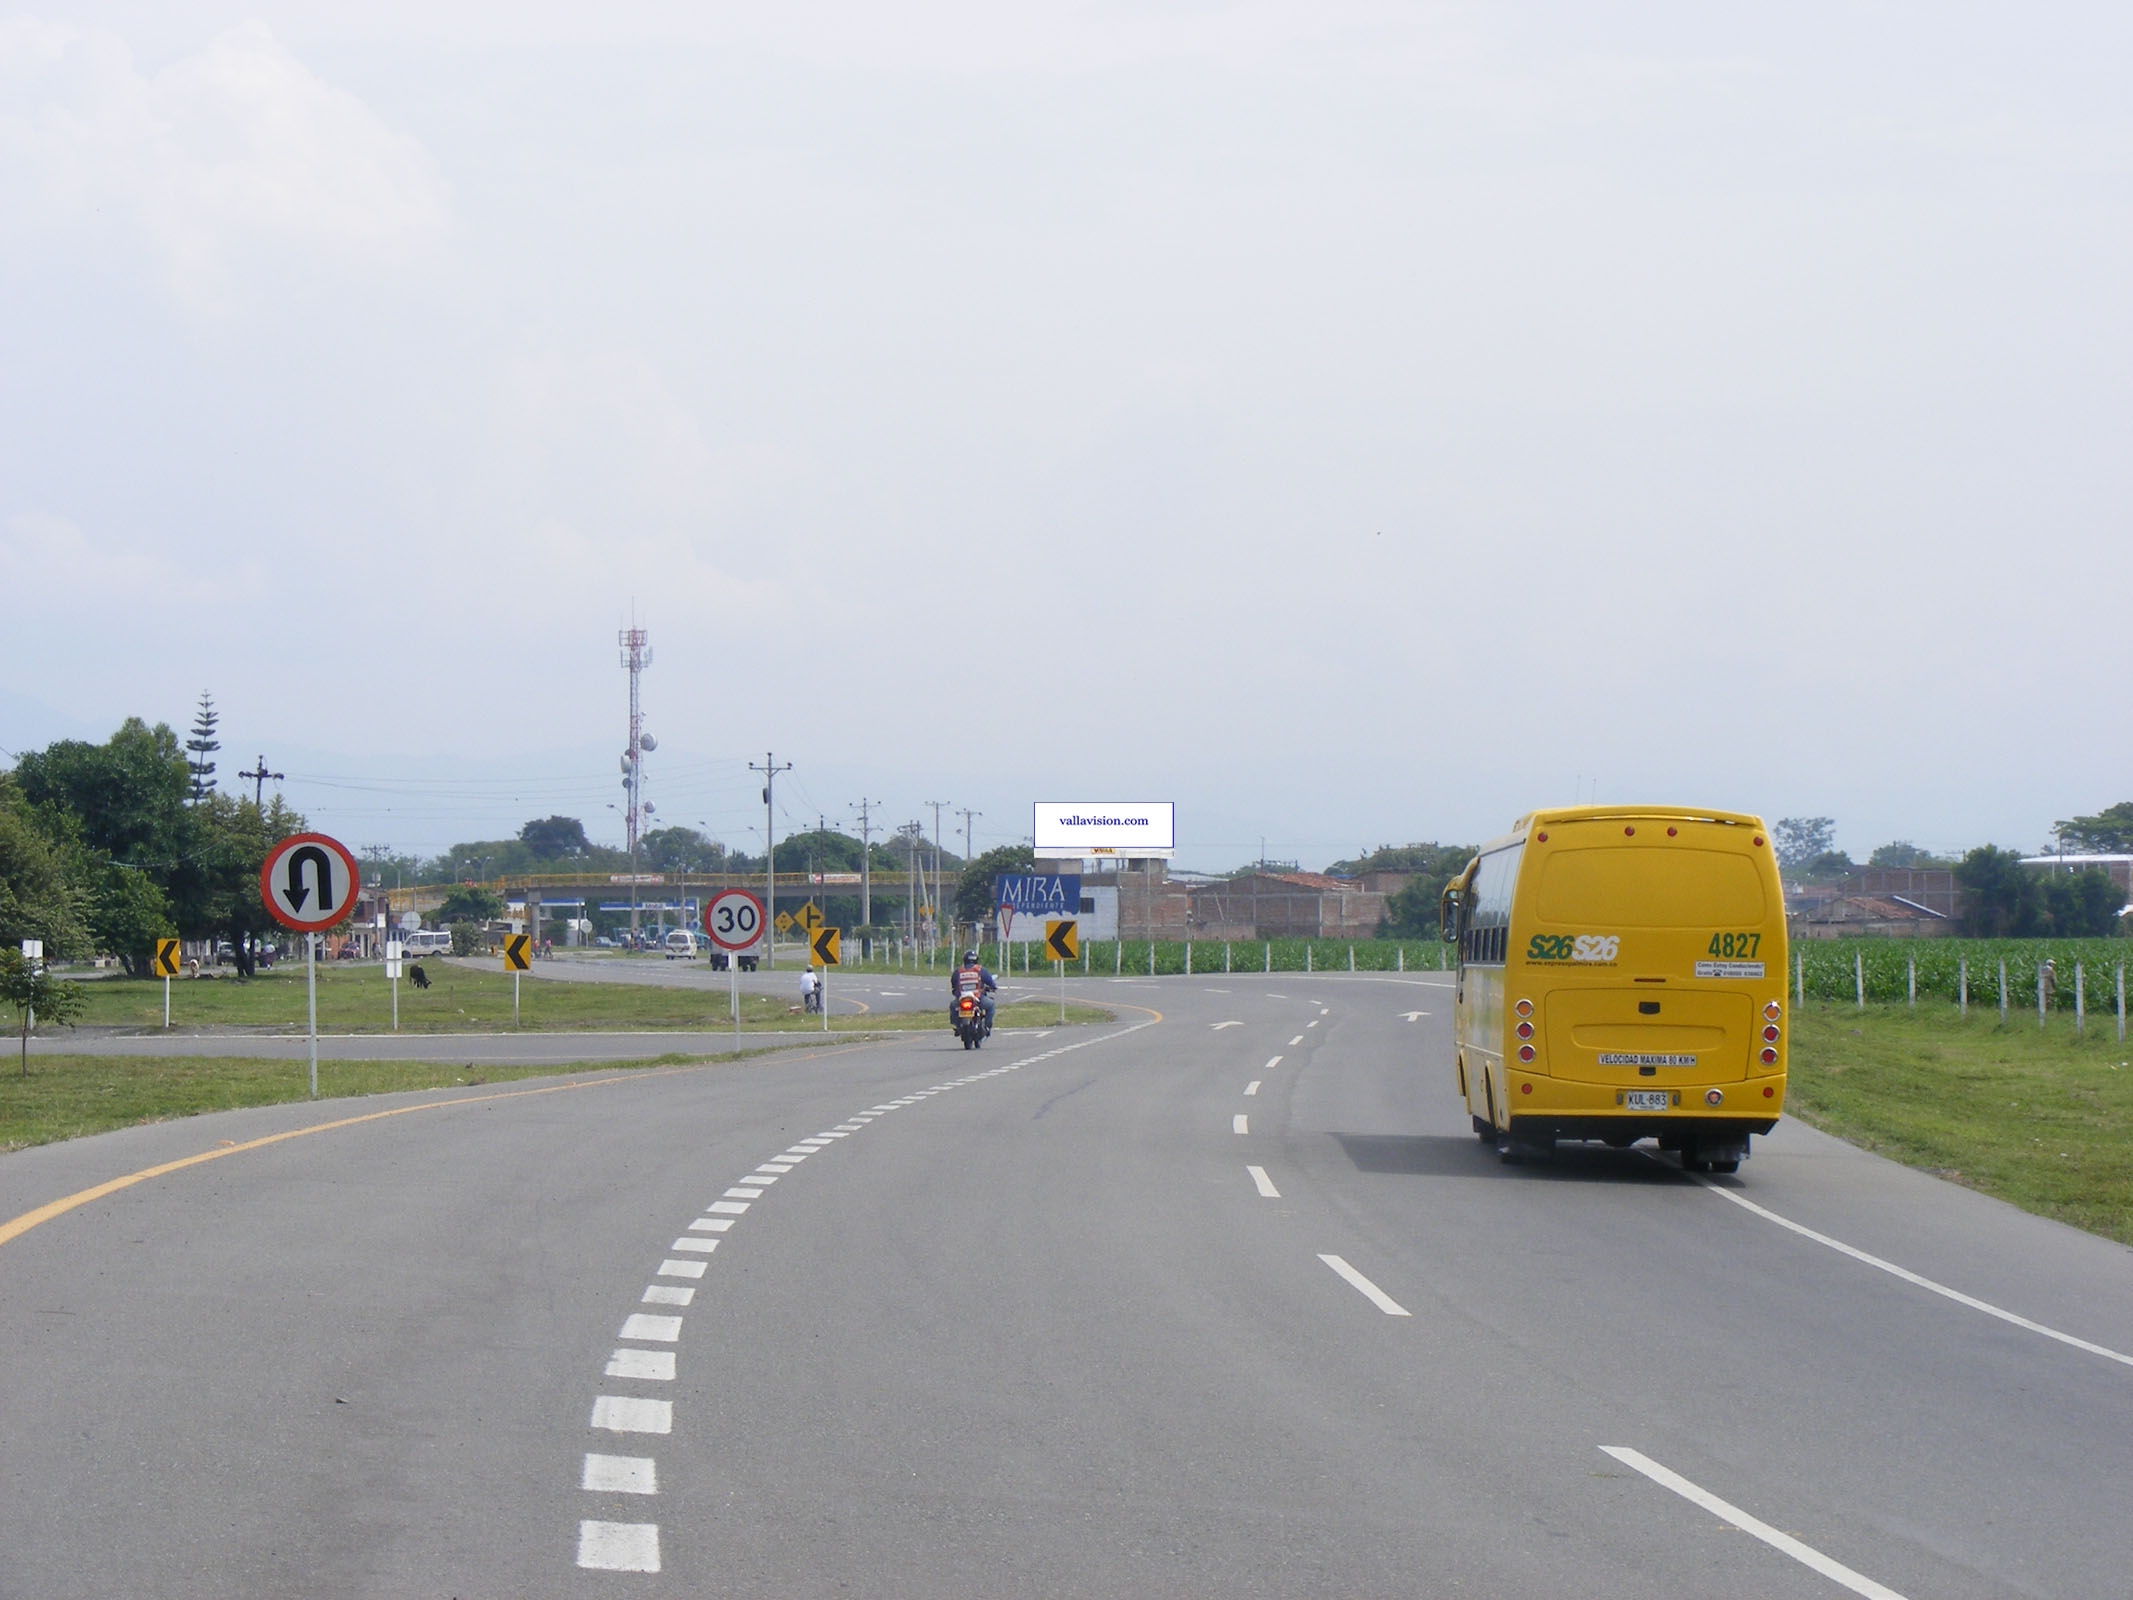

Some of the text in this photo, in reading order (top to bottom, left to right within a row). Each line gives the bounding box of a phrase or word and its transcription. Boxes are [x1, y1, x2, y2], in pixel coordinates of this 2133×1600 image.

[1059, 815, 1149, 826] vallavision.com
[1002, 876, 1065, 902] MIRA
[717, 905, 756, 933] 30
[1708, 932, 1761, 958] 4827
[1601, 1054, 1639, 1064] VELOCIDAD
[1640, 1055, 1667, 1065] MAXIMA
[1669, 1055, 1678, 1065] 80
